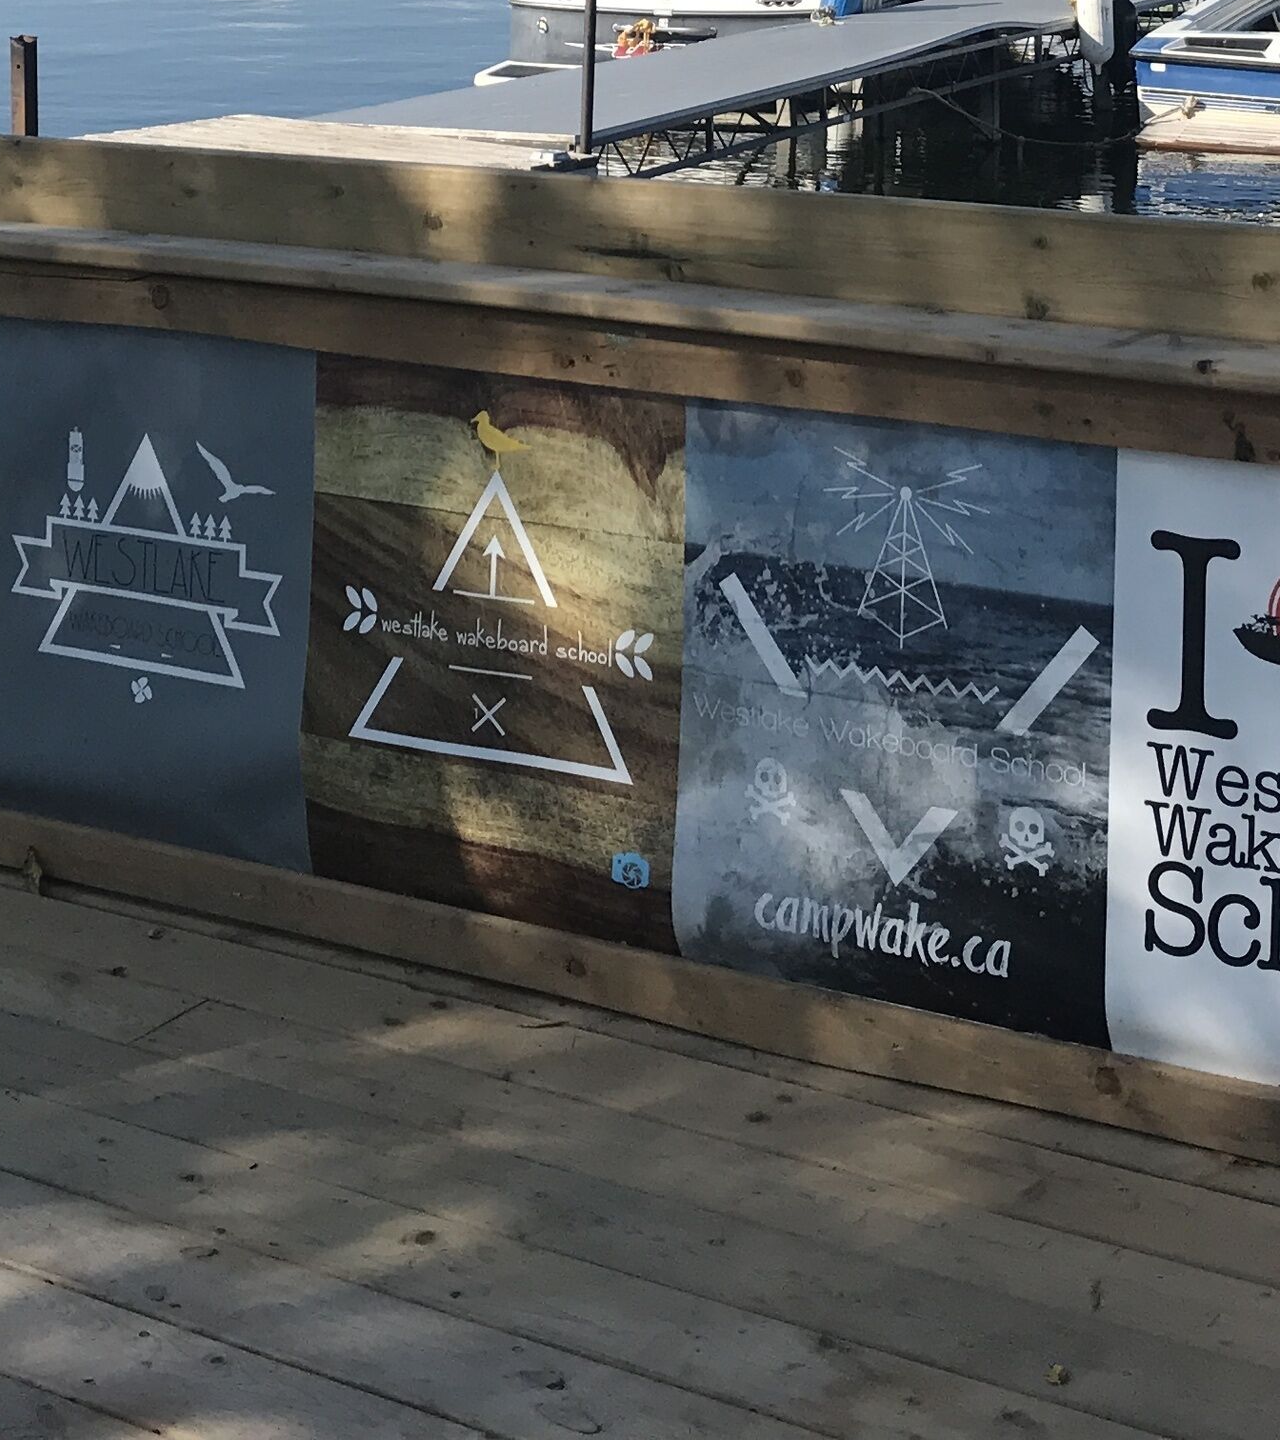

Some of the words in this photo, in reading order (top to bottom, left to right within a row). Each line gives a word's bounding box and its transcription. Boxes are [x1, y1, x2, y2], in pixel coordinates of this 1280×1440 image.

[63, 530, 225, 603] WESTLAKE
[381, 610, 449, 642] westlake
[456, 618, 548, 656] wakeboard
[555, 630, 612, 668] school
[1147, 529, 1241, 739] I
[693, 691, 810, 738] Westlake
[820, 717, 978, 768] Wakeboard
[989, 747, 1087, 788] School
